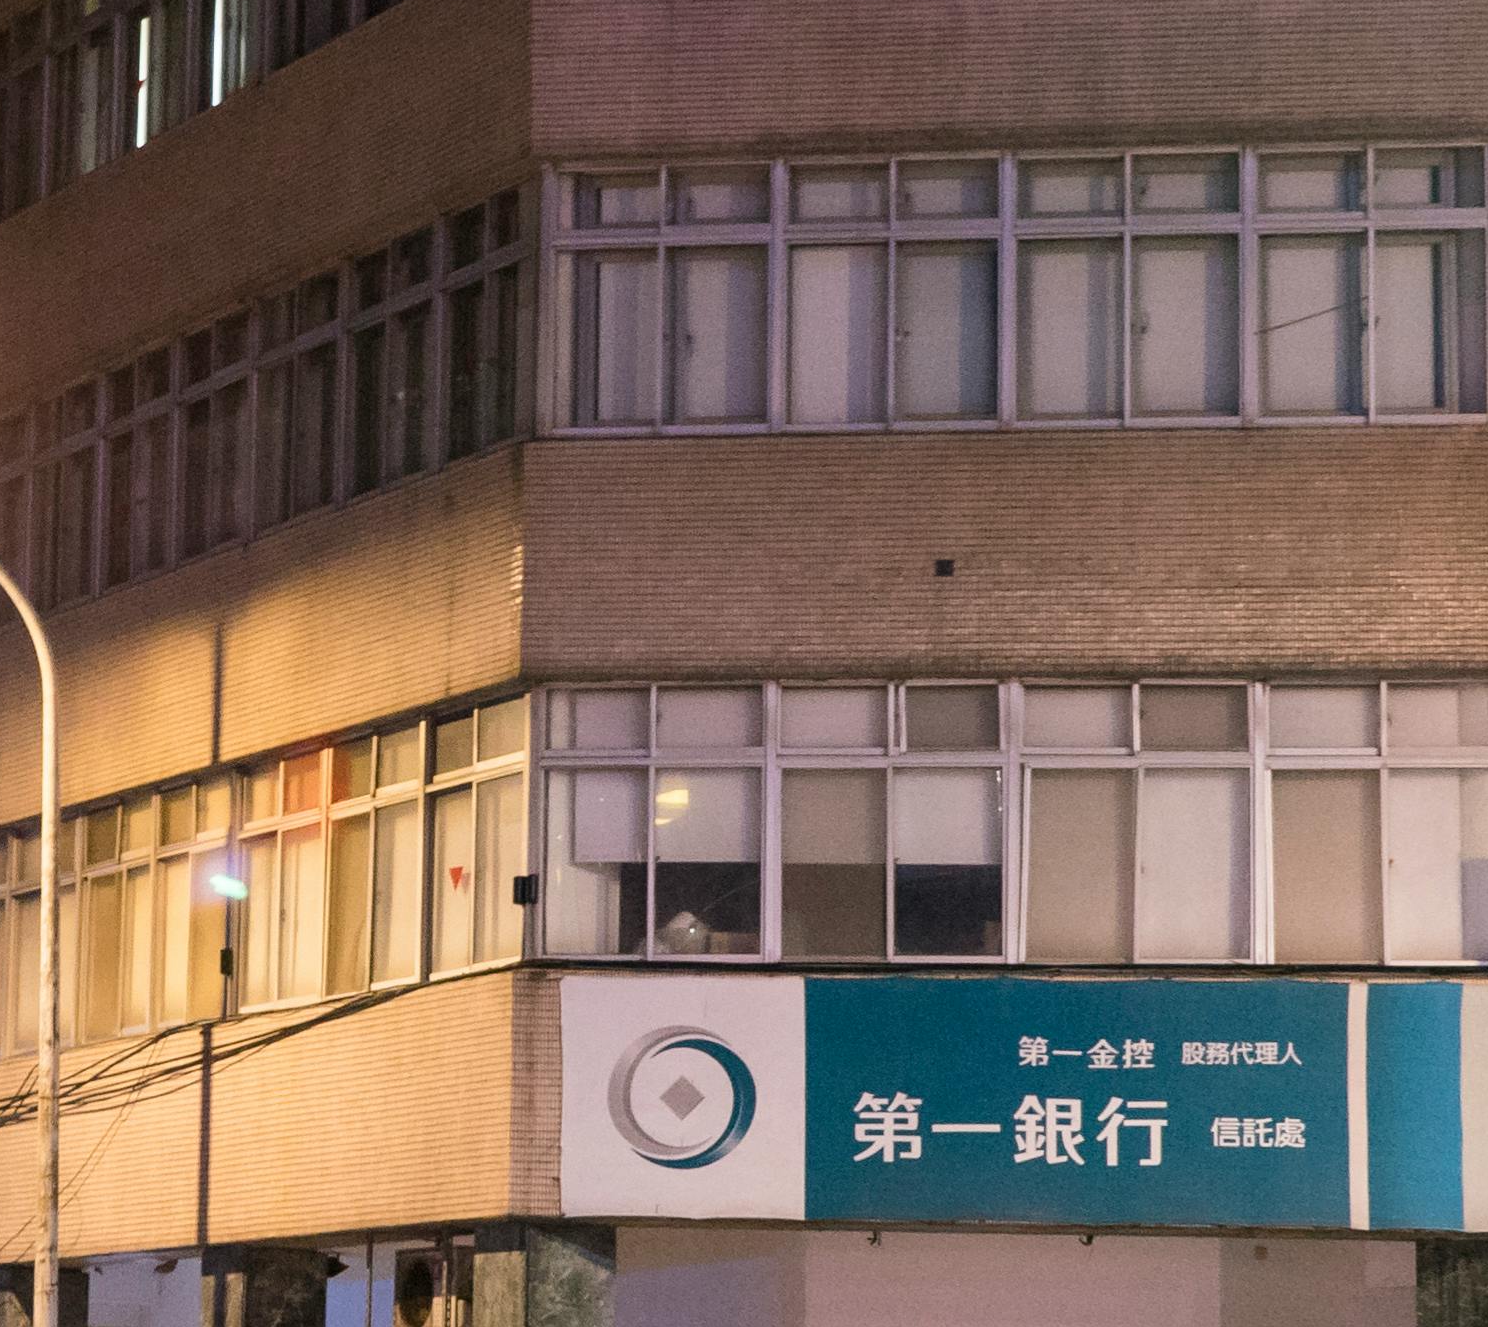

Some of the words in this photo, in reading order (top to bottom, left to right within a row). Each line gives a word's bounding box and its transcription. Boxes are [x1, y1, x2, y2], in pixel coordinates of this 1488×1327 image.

[1017, 1036, 1156, 1071] 第一金控
[1180, 1040, 1304, 1068] 股務代理人
[852, 1091, 1169, 1168] 第一銀行
[1209, 1116, 1307, 1151] 信託處
